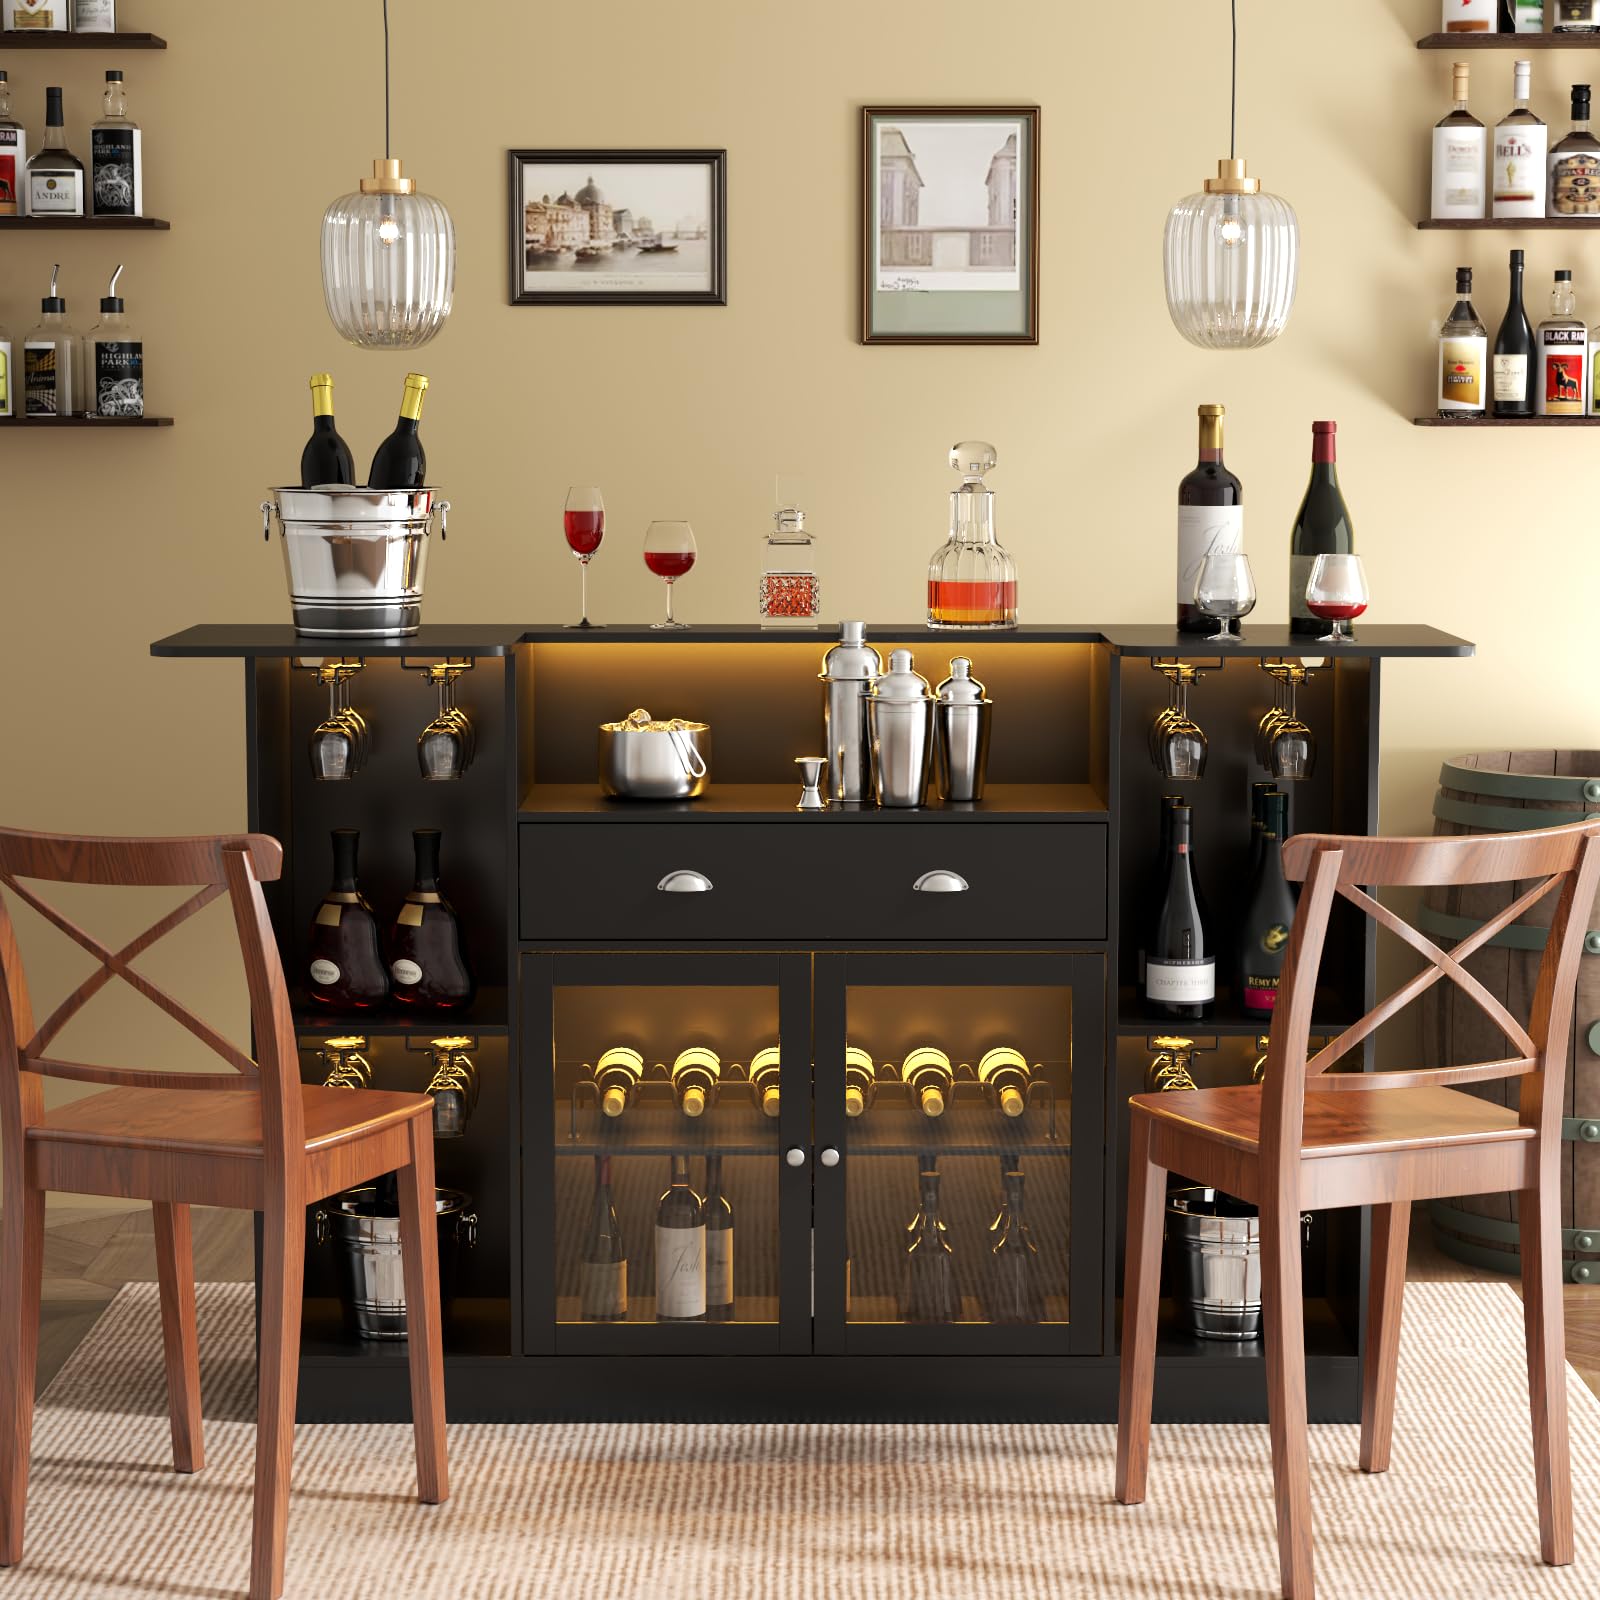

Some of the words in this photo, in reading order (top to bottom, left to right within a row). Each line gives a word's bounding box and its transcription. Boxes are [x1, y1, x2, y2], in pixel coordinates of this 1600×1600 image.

[0, 131, 17, 142] RAM
[1496, 143, 1531, 158] BELL'S
[1545, 331, 1569, 341] BLACK
